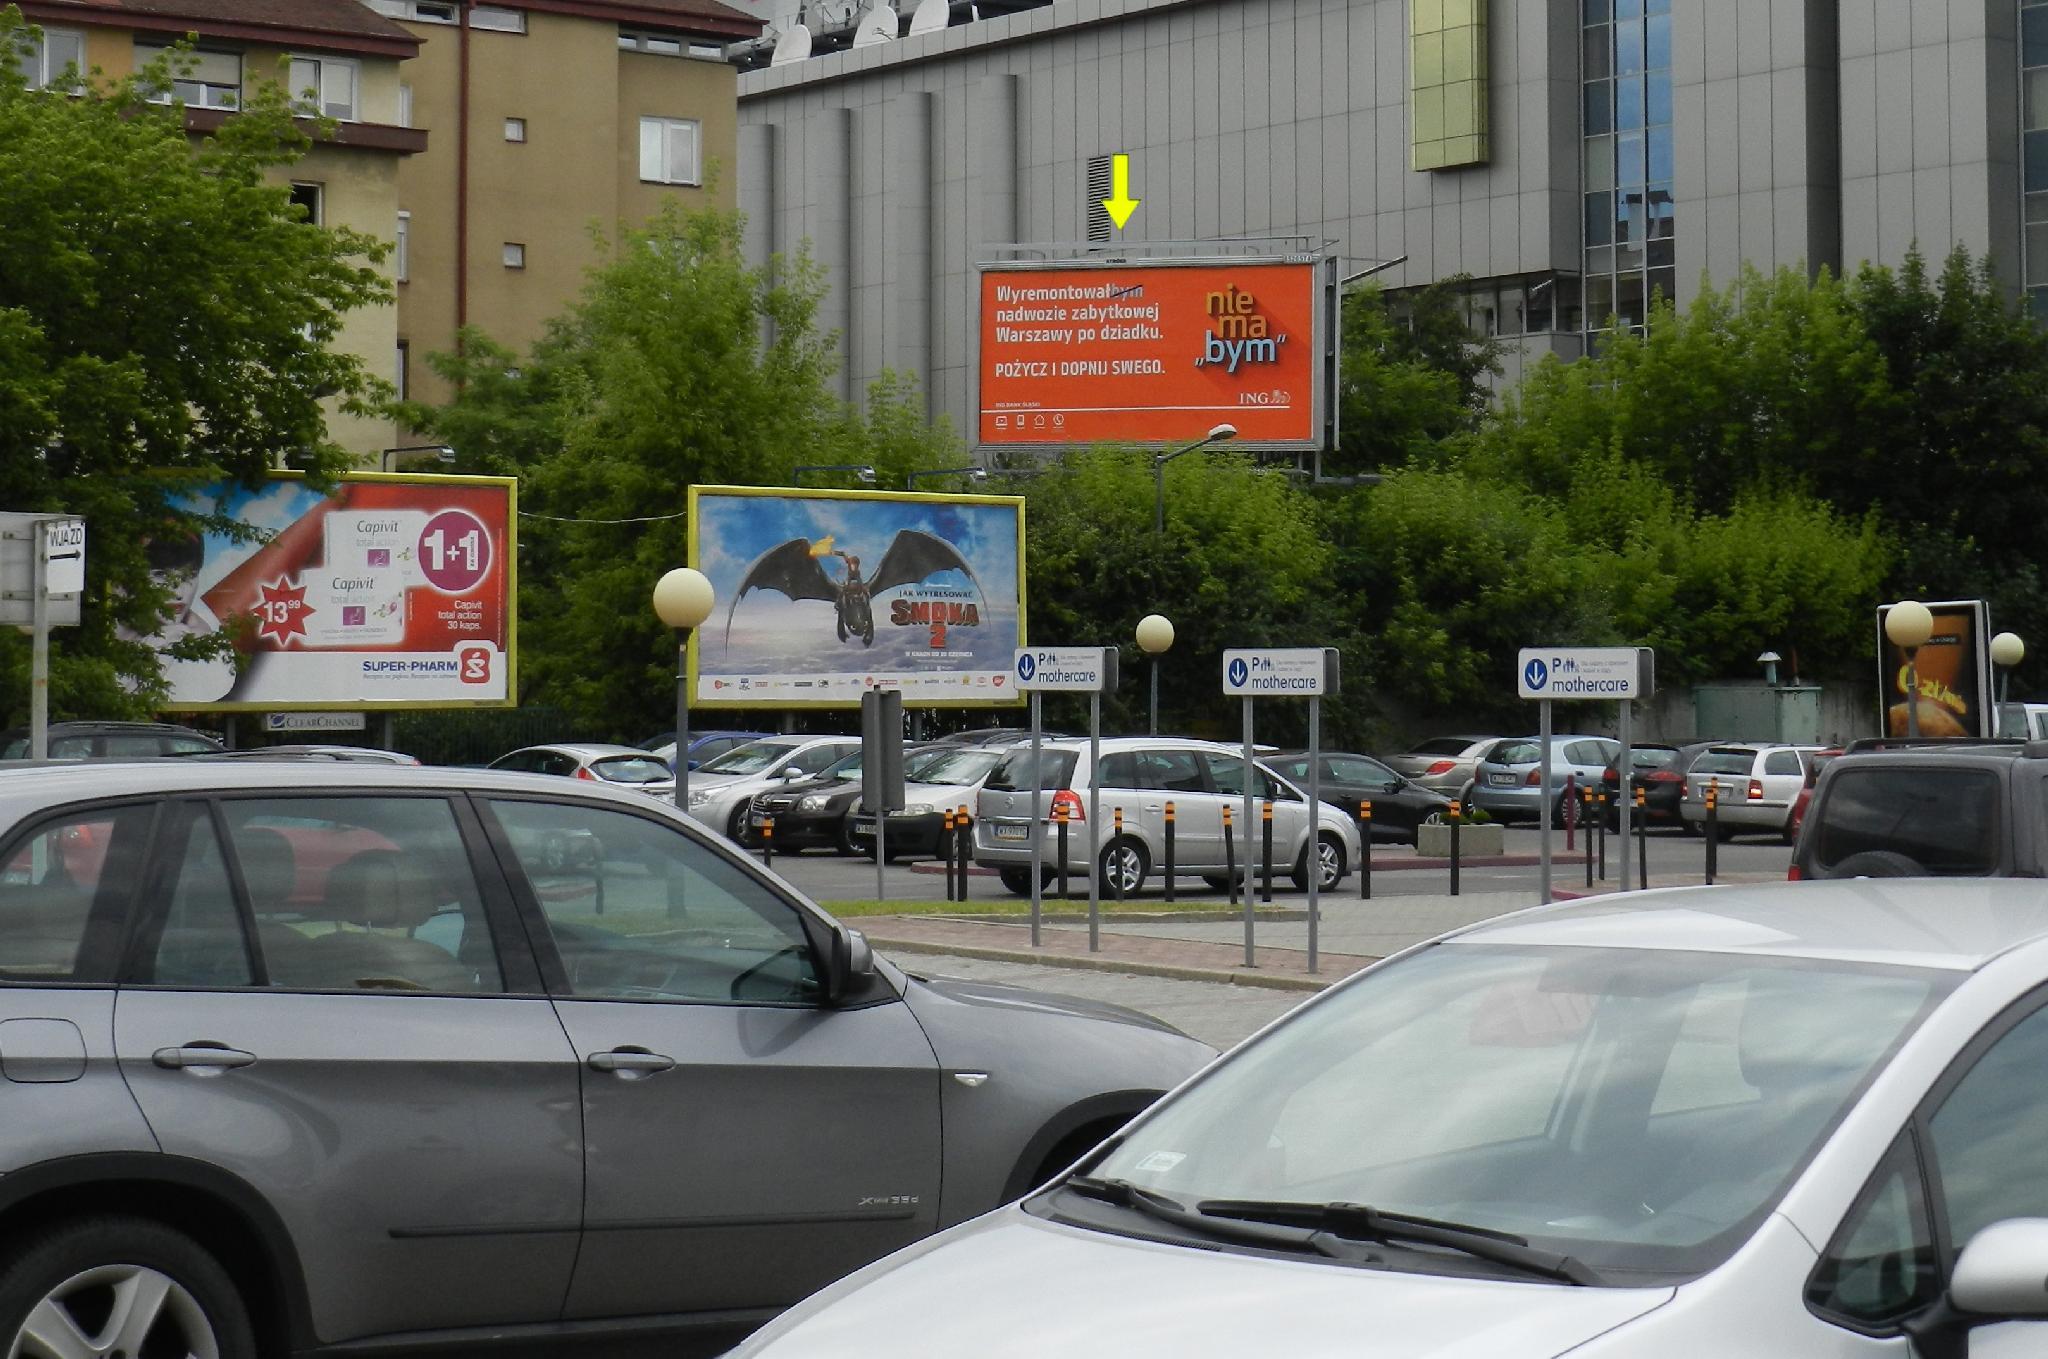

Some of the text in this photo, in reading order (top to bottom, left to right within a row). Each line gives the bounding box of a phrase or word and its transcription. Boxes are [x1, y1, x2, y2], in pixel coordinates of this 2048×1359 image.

[1206, 282, 1254, 314] nie
[997, 302, 1159, 323] nadwozie zabytkowej
[996, 323, 1164, 344] Warszawy po dziadku.
[1218, 314, 1267, 338] ma
[996, 359, 1166, 377] POŻYCZ I DOPNIJ SWEGO.
[1240, 392, 1269, 405] ING
[357, 520, 398, 536] Capivit
[50, 528, 83, 546] WJAZD
[424, 529, 479, 571] 1+1
[332, 577, 374, 592] Capivit
[899, 589, 914, 598] JAK
[454, 600, 482, 610] Capivit
[890, 598, 980, 626] SMOKA
[438, 610, 482, 619] total action
[447, 620, 482, 631] 30 kaps.
[930, 624, 946, 649] 2
[362, 660, 458, 671] SUPER-PHARM
[1038, 668, 1096, 683] mothercare
[1252, 675, 1317, 689] mothercare
[1552, 676, 1629, 692] mothercare
